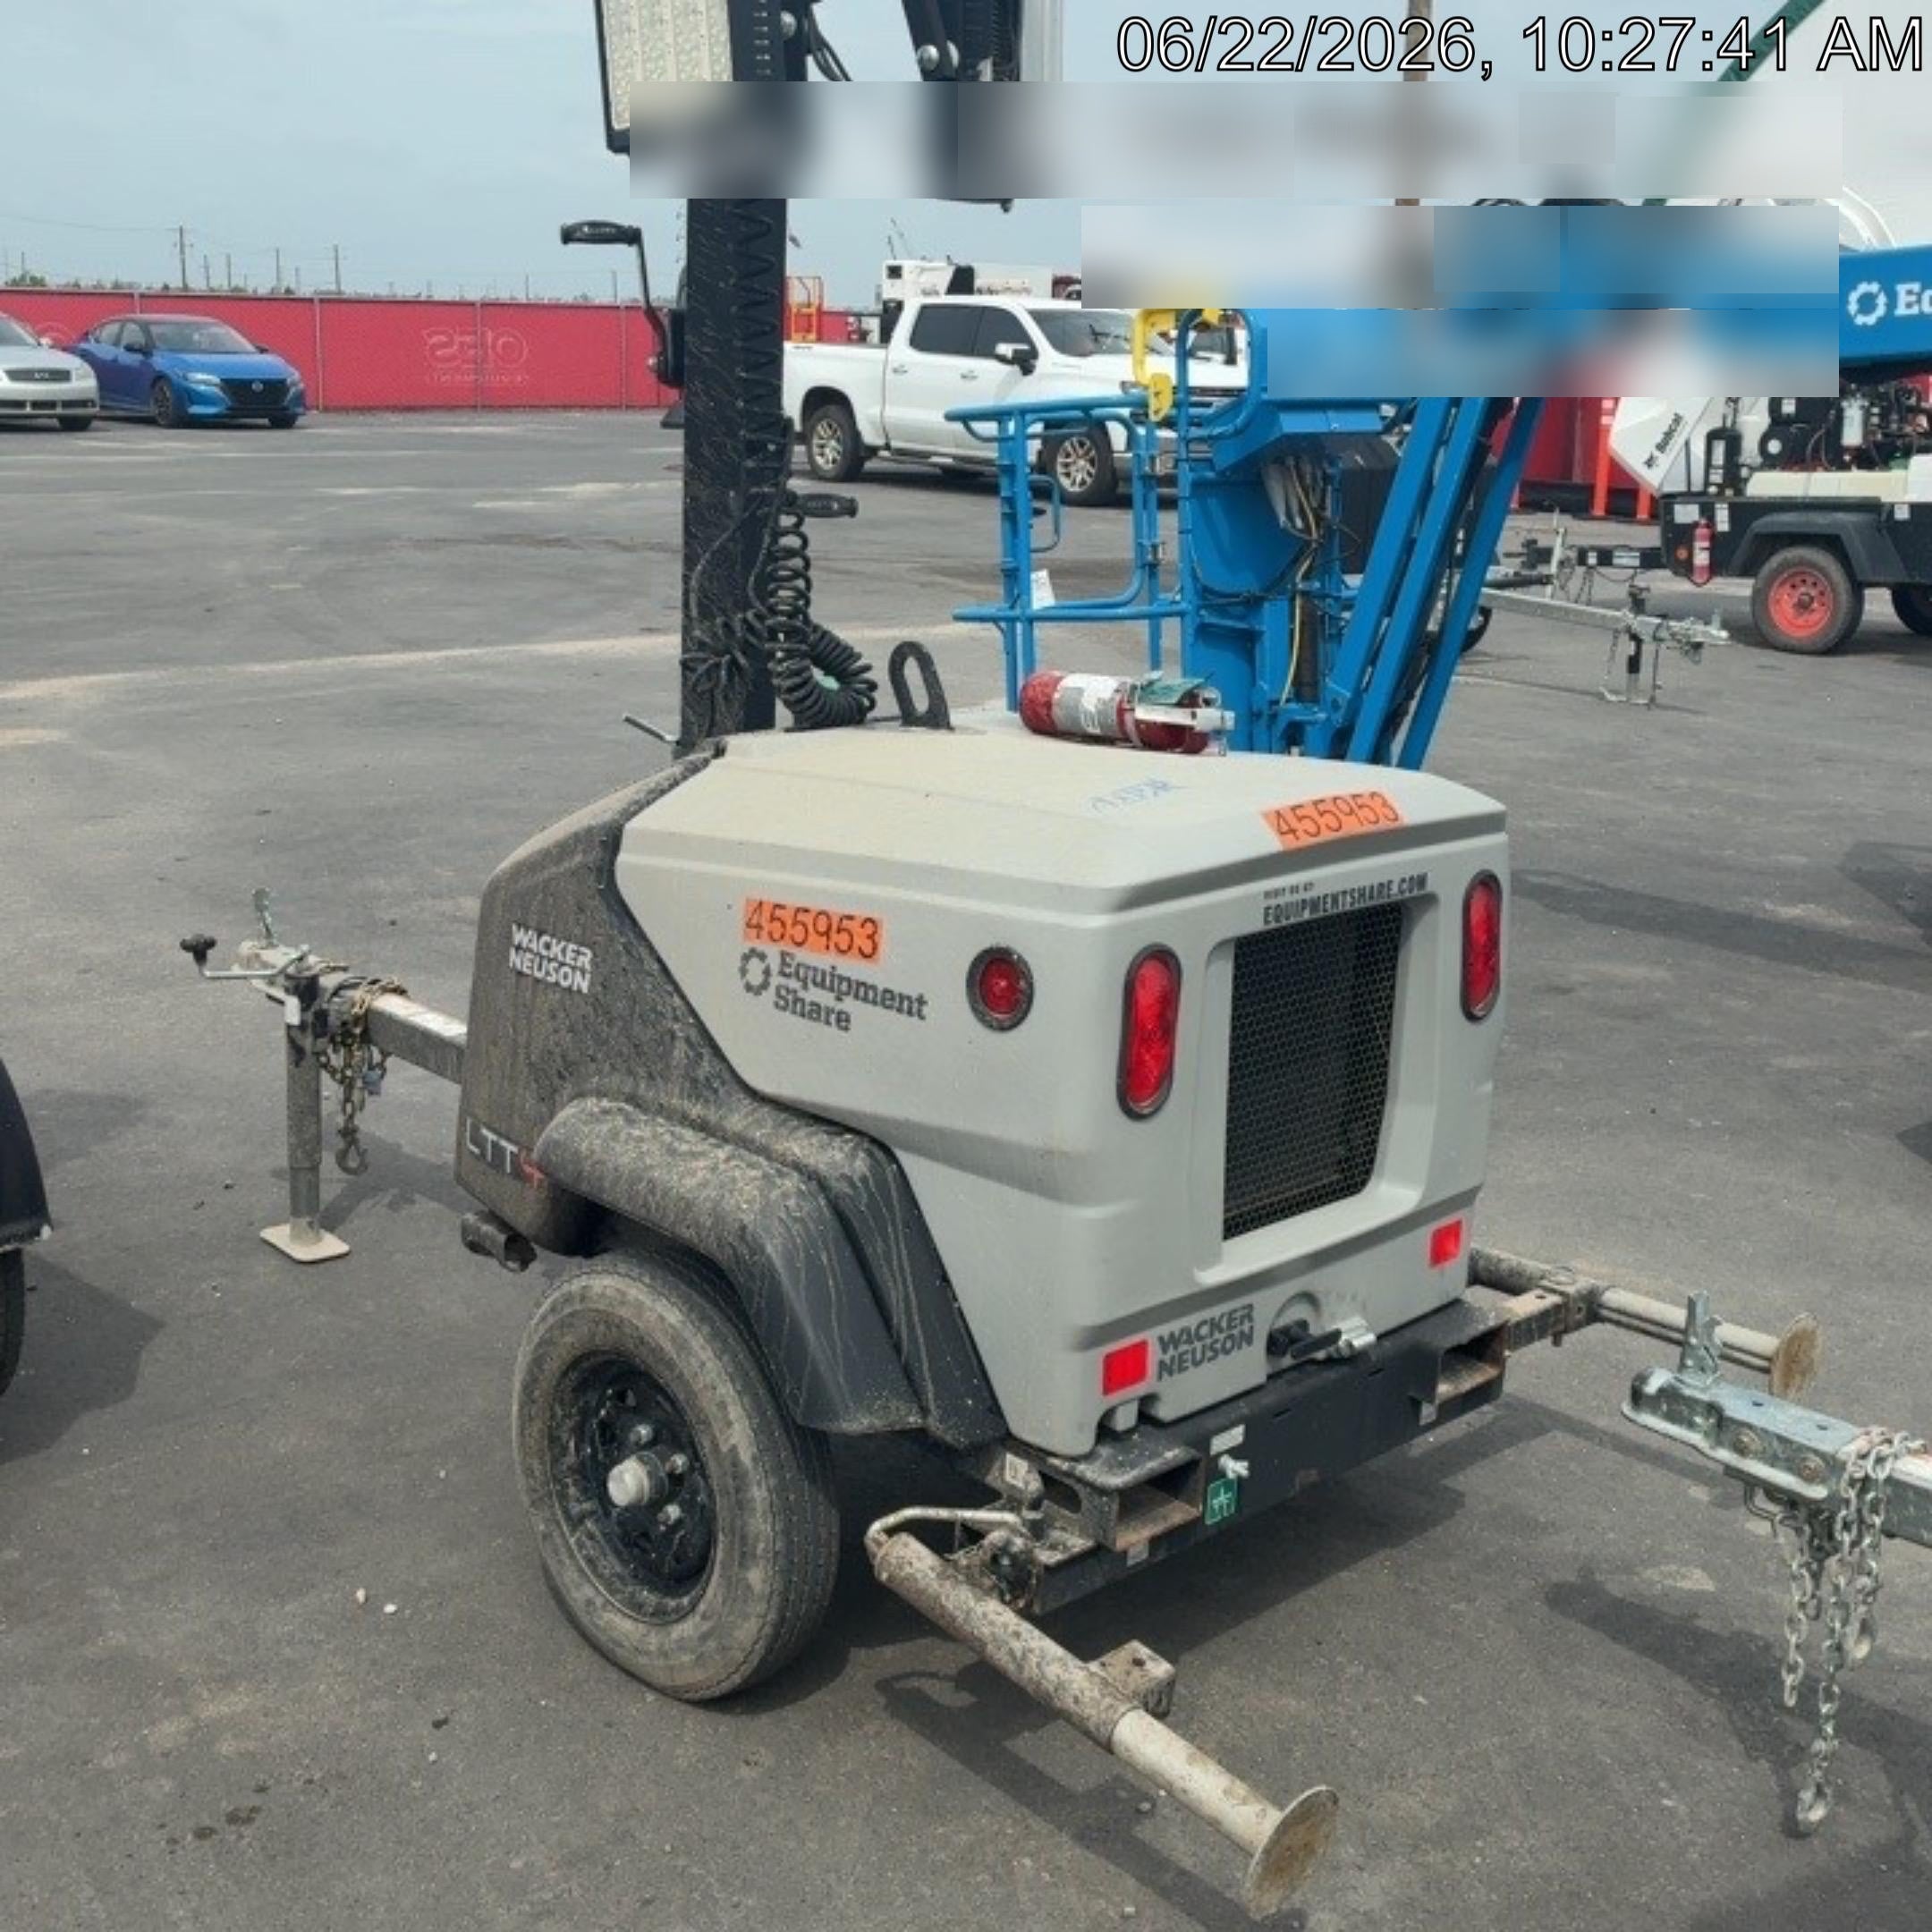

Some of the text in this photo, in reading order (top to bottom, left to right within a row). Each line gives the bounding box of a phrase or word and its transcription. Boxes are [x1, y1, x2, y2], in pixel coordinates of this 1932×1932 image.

[1274, 791, 1399, 841] 455953
[1263, 871, 1428, 927] EQUIPMENTSHARE.COM
[512, 923, 592, 971] WACKER
[744, 900, 878, 959] 455953
[509, 947, 591, 995] NEUSON
[777, 950, 928, 1021] Equipment
[773, 983, 852, 1033] Share
[1157, 1303, 1254, 1355] WACKER
[1157, 1325, 1254, 1382] NEUSON
